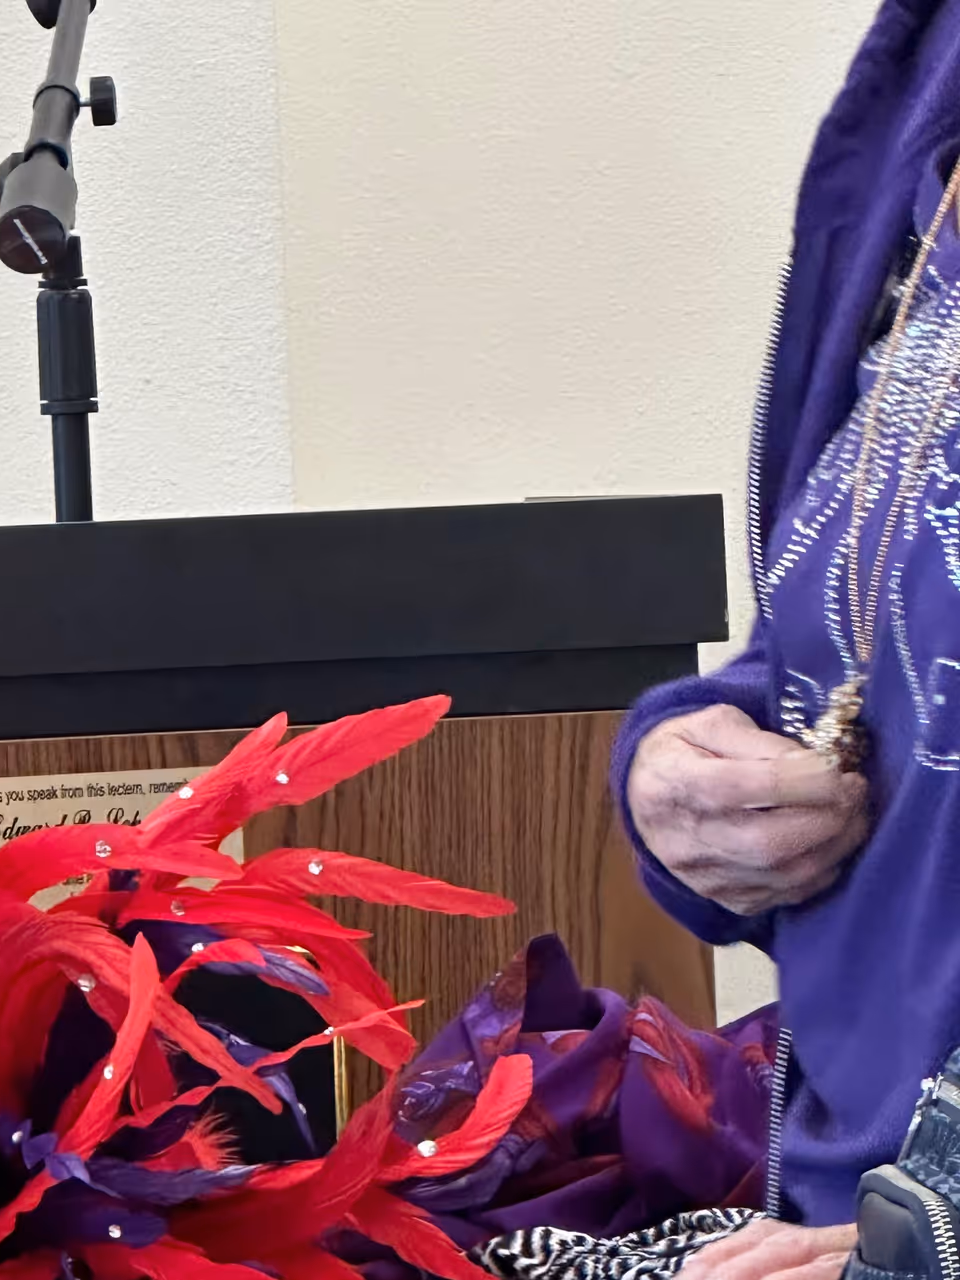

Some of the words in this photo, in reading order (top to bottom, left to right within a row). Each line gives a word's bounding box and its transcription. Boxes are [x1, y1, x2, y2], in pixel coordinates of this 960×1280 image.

[4, 790, 25, 806] you
[26, 786, 58, 804] speak
[60, 784, 84, 799] from
[87, 782, 106, 798] this
